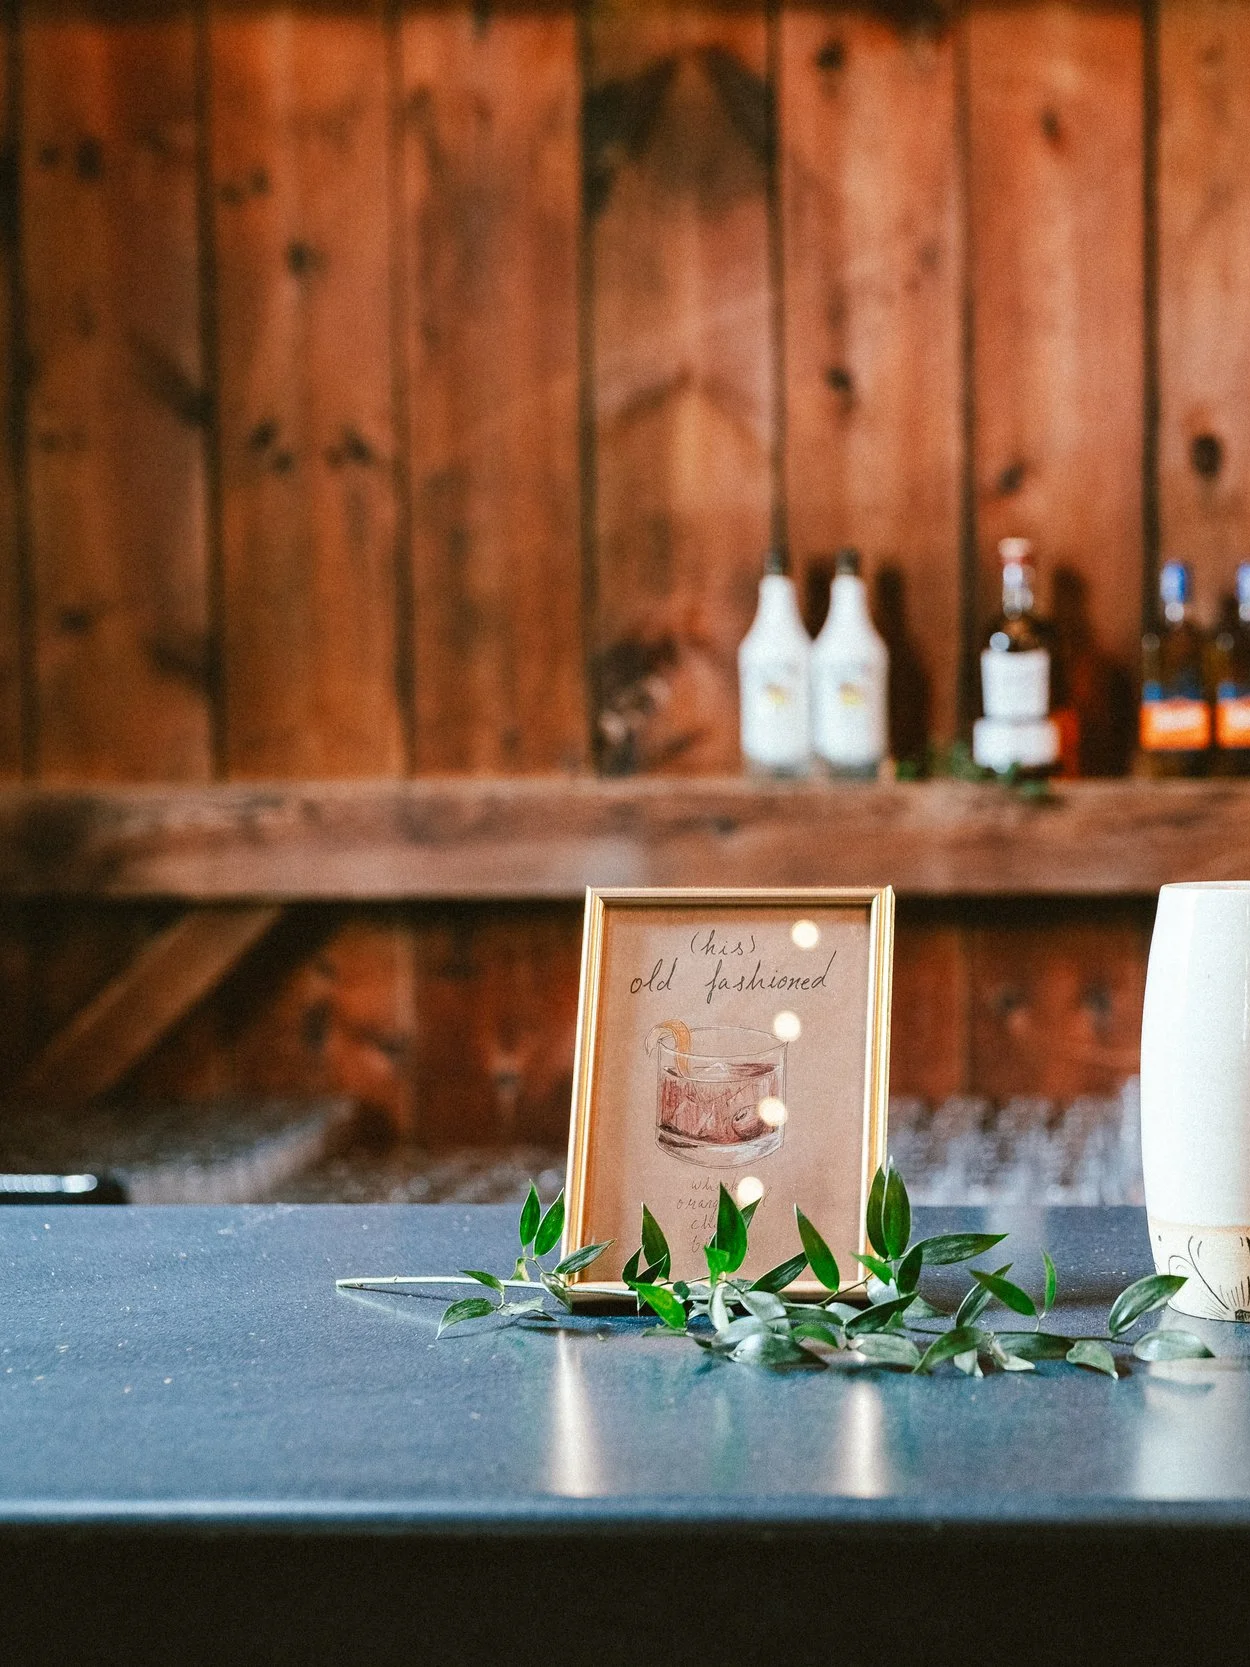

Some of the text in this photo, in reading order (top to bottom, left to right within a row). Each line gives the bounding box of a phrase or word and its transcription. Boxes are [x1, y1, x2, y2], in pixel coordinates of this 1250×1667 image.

[690, 929, 756, 956] (his)
[630, 950, 837, 1004] old fashioned
